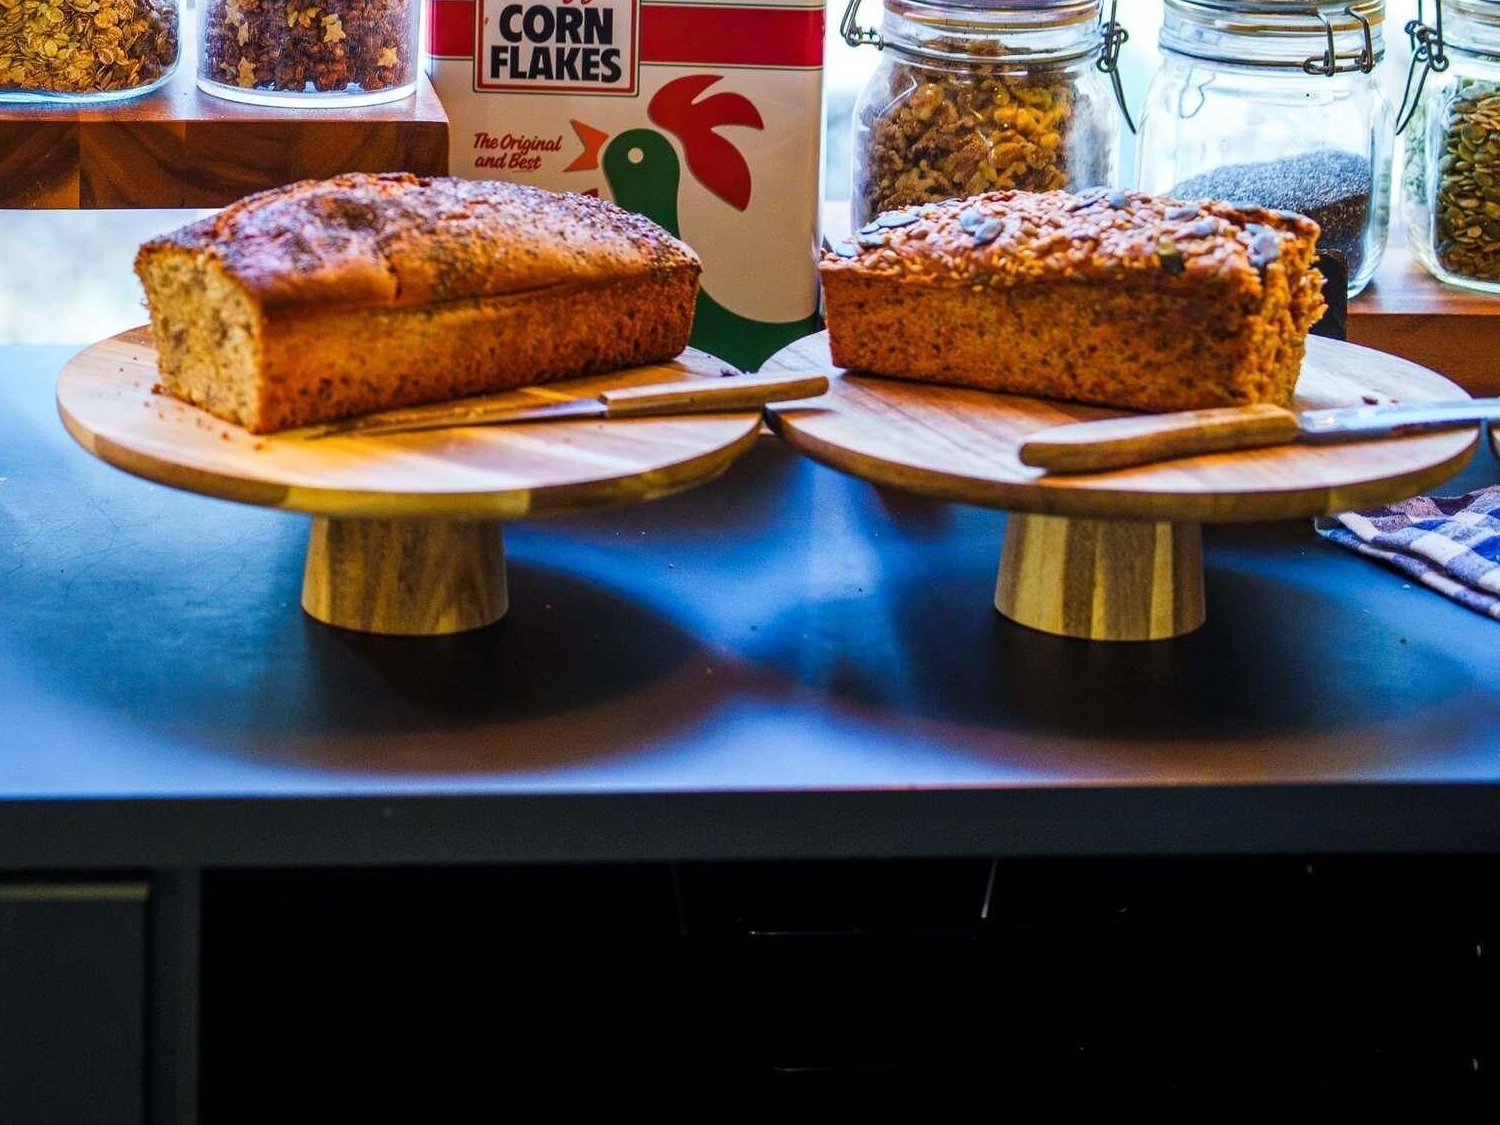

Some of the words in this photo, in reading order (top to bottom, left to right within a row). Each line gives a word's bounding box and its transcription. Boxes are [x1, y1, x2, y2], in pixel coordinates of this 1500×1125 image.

[499, 4, 614, 45] CORN
[490, 45, 622, 84] FLAKES
[473, 132, 499, 150] The
[500, 133, 563, 156] Original
[474, 153, 508, 170] and
[508, 152, 542, 171] Best
